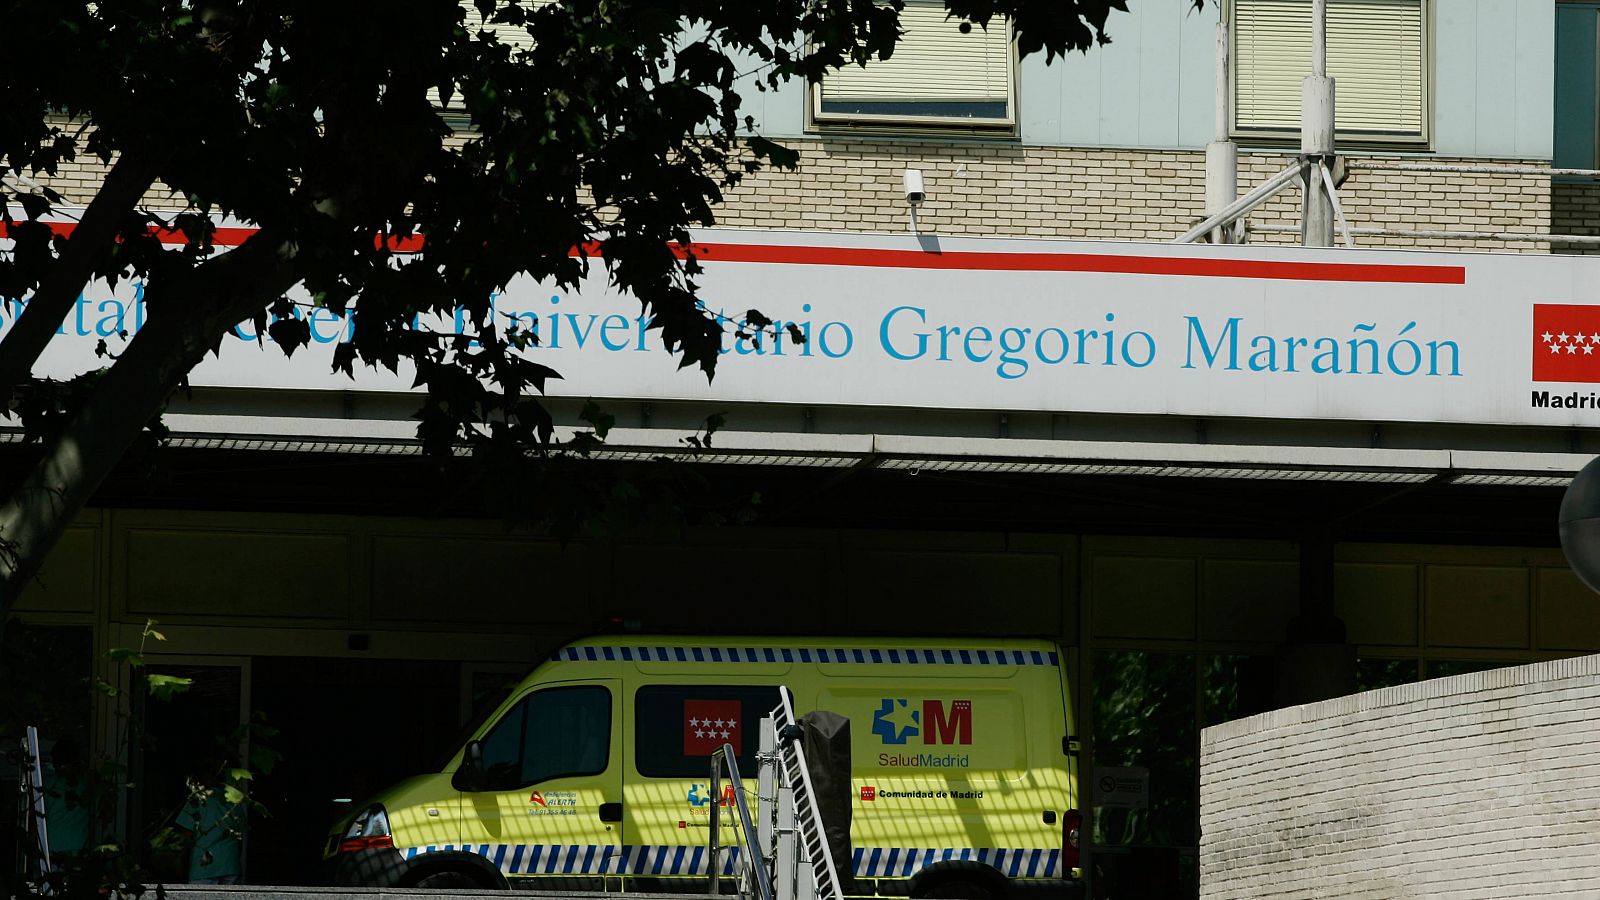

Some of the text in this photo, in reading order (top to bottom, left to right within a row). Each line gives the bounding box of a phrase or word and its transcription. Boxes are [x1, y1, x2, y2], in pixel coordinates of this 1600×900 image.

[879, 306, 1157, 379] Gregorio
[1182, 316, 1463, 377] Marañón
[1532, 391, 1600, 409] Madri
[879, 753, 969, 768] SaludMadrid
[879, 790, 983, 799] Comunidad de Madrid
